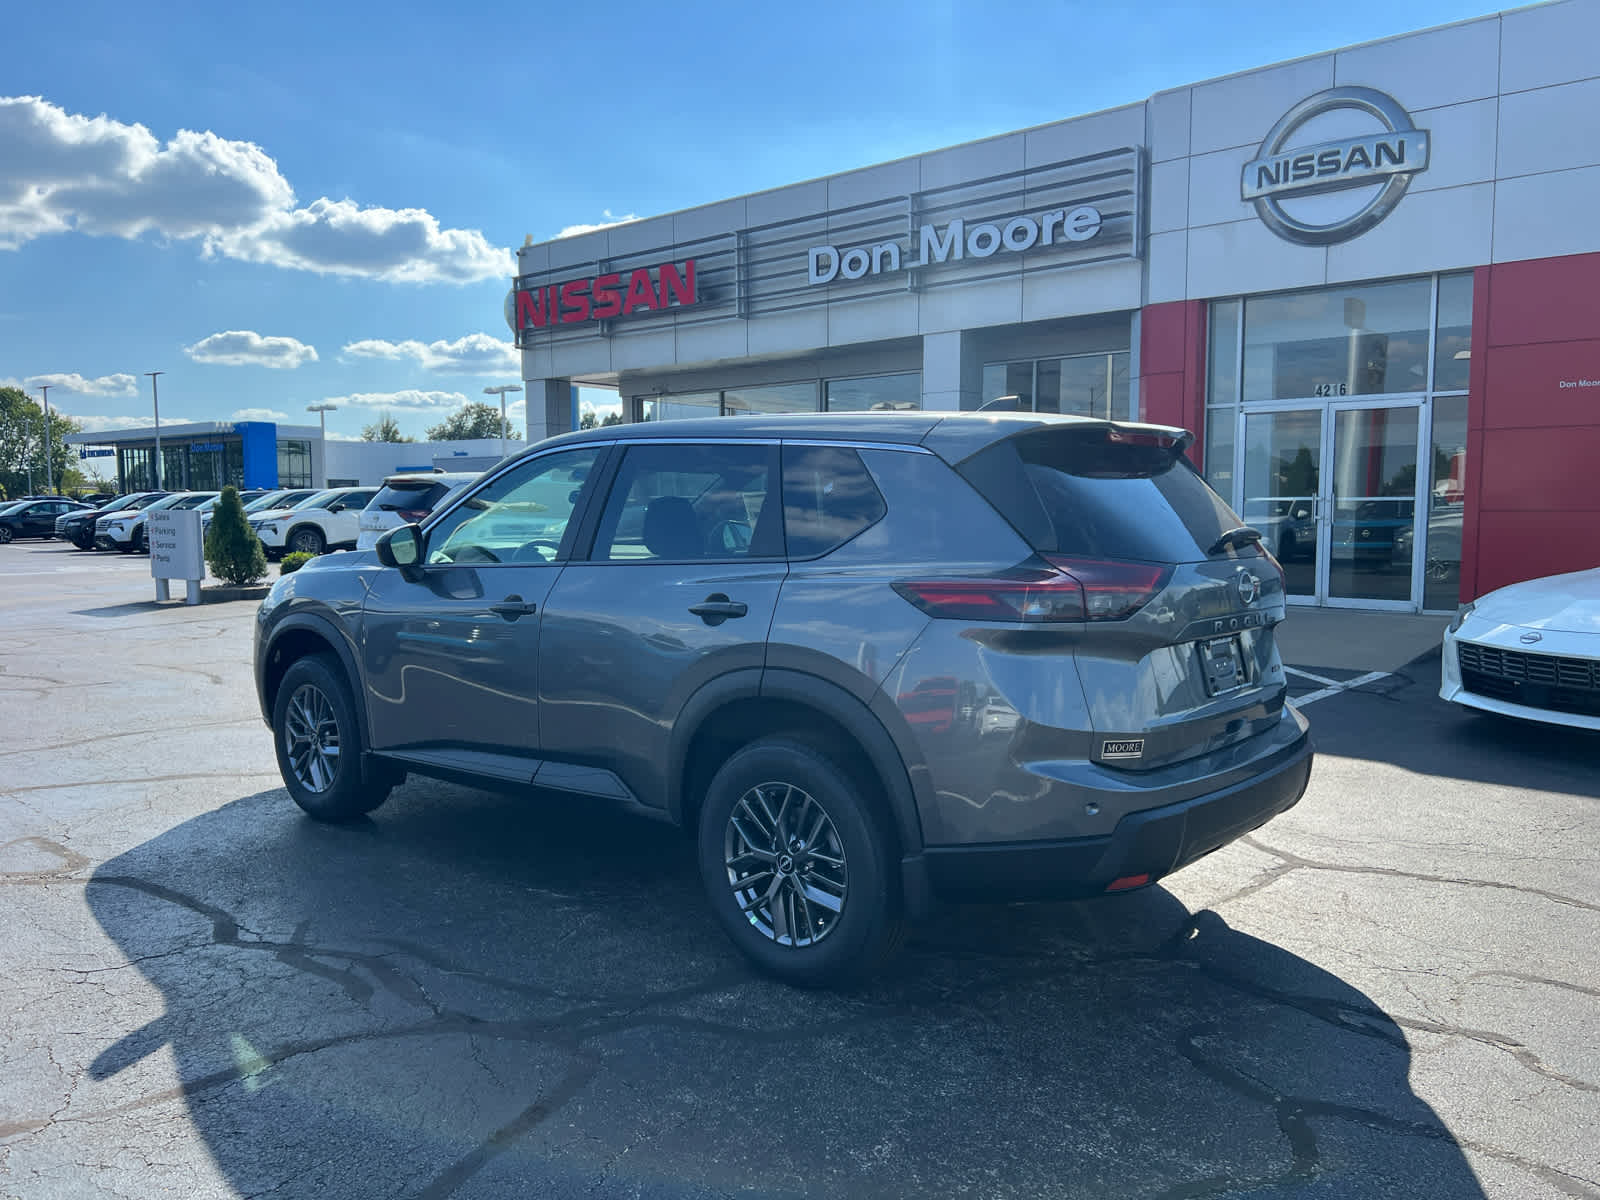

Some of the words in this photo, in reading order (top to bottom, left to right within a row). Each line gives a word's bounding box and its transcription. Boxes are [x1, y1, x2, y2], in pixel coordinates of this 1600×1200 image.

[1257, 140, 1405, 189] NISSAN
[808, 242, 900, 285] Don
[920, 205, 1102, 265] Moore
[517, 259, 696, 330] NISSAN
[1559, 380, 1577, 388] Don
[154, 513, 170, 521] Sales
[155, 528, 176, 537] Parking
[156, 541, 177, 549] Service
[1106, 743, 1141, 753] MOORE
